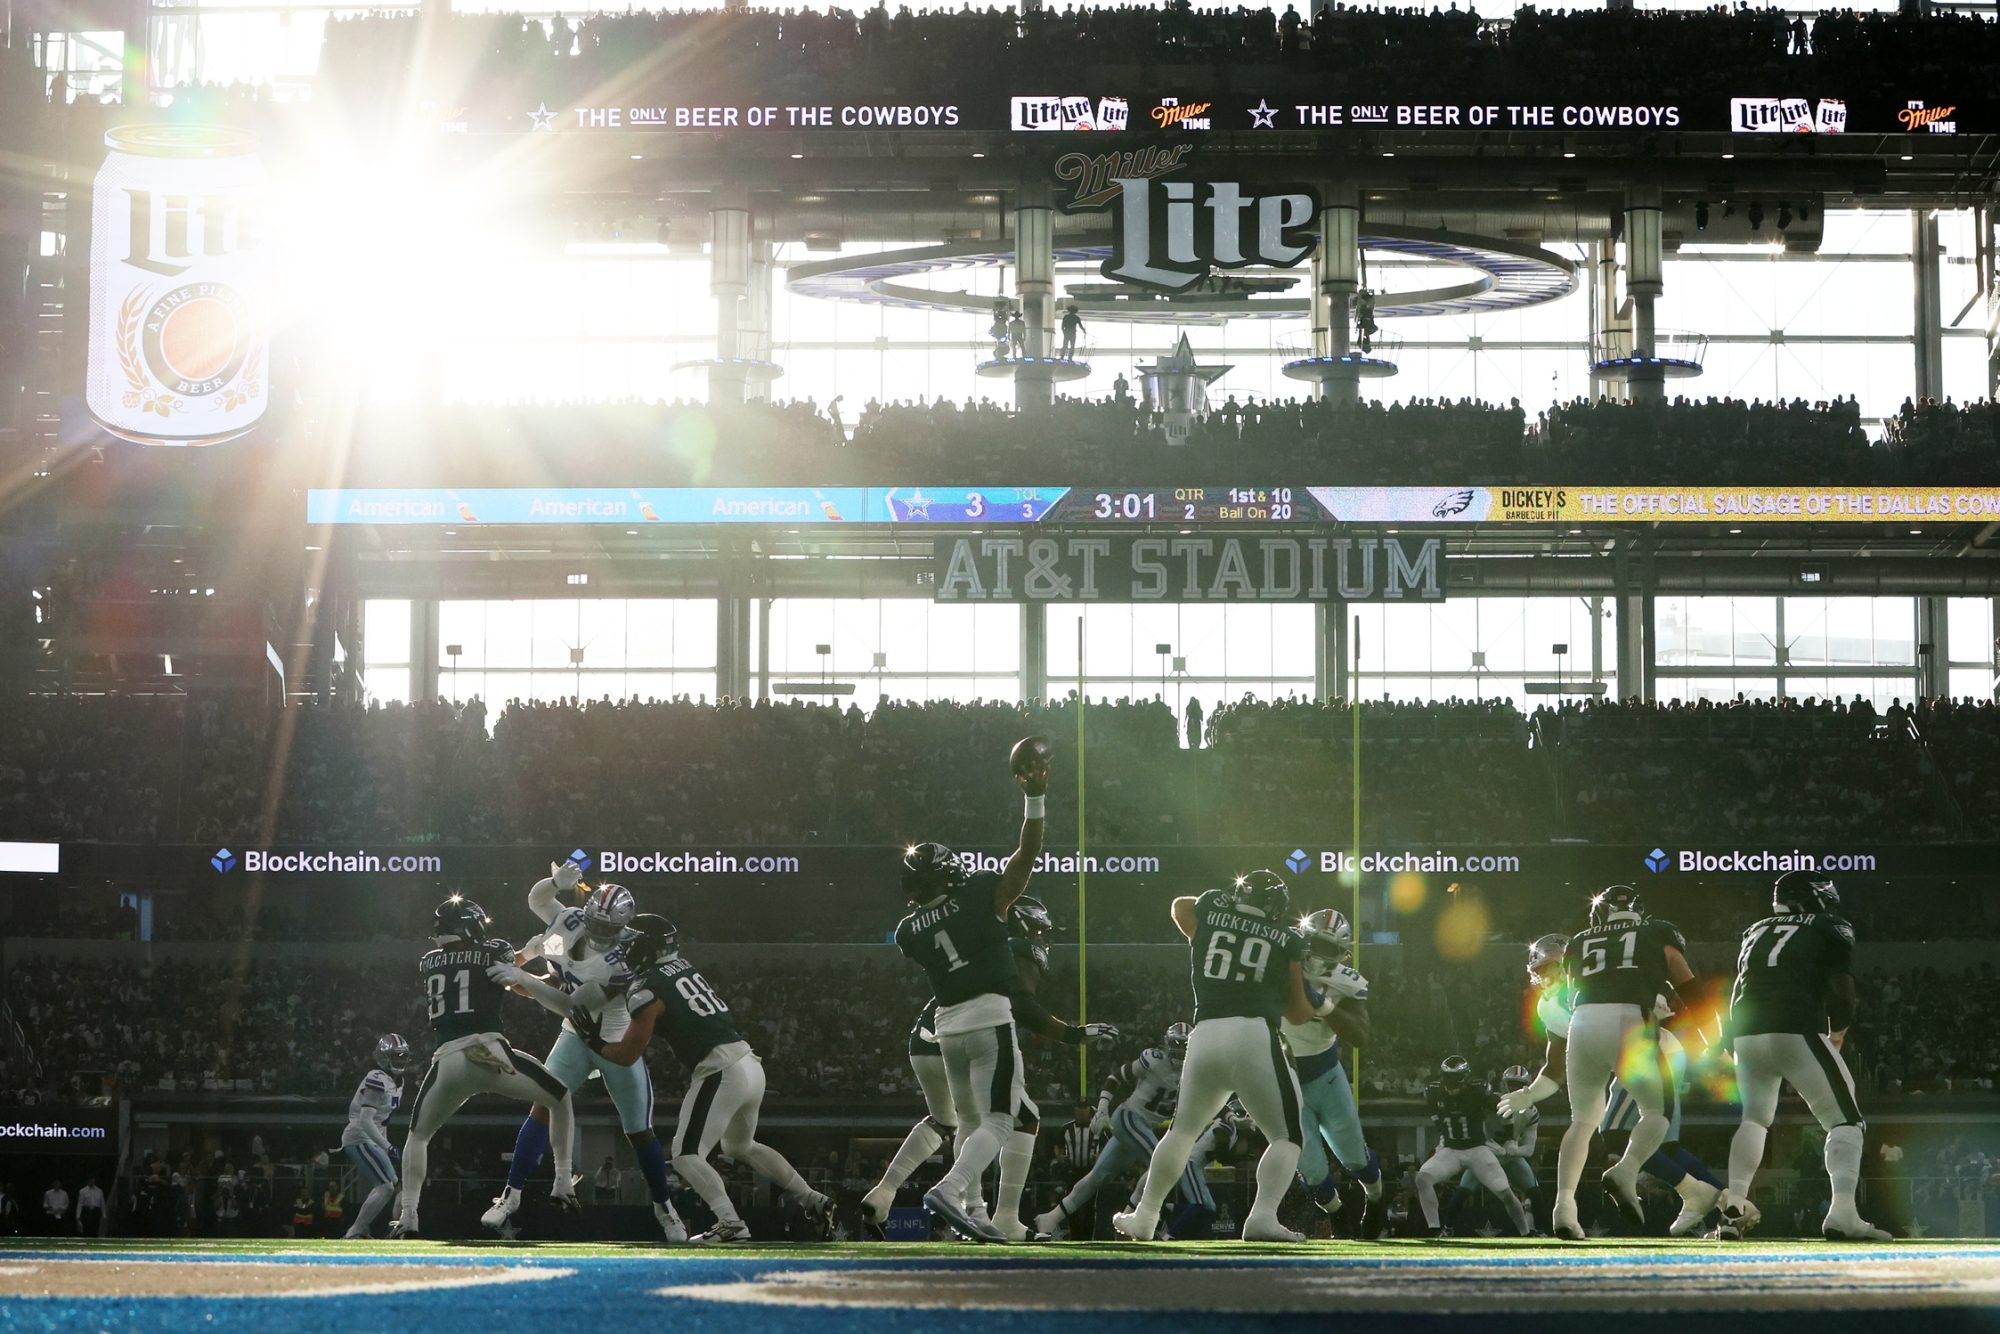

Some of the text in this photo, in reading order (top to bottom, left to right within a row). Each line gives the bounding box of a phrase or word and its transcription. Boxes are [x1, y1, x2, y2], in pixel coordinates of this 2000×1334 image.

[575, 106, 960, 127] THE ONLY BEER OF THE COWBOYS
[1020, 102, 1060, 129] Lite
[1062, 99, 1089, 124] Lite
[1103, 106, 1128, 123] Lite
[1152, 102, 1211, 128] Miller
[1296, 105, 1680, 126] THE ONLY BEER OF THE COWBOYS
[1740, 103, 1779, 130] Lite
[1781, 101, 1808, 125] Lite
[1822, 108, 1845, 125] Lite
[1898, 106, 1956, 131] Miller
[1182, 118, 1210, 130] TIME
[1928, 121, 1956, 133] TIME
[1055, 144, 1193, 208] Miller
[1110, 178, 1314, 287] Lite
[156, 288, 193, 319] FINE
[176, 377, 226, 394] BEER
[965, 492, 984, 518] 3
[1175, 488, 1204, 501] QTR
[1229, 488, 1256, 503] 1st
[1271, 488, 1292, 503] 10
[1502, 491, 1566, 508] DICKEYS
[1580, 495, 1618, 515] THE
[1623, 495, 1710, 515] OFFICIAL
[1714, 495, 1801, 515] SAUSAGE
[1806, 495, 1832, 515] OF
[1835, 495, 1873, 515] THE
[1878, 495, 1950, 515] DALLAS
[348, 498, 446, 516] American
[529, 497, 627, 517] American
[712, 496, 810, 516] American
[1022, 503, 1033, 518] 3
[1094, 494, 1155, 519] 3:01
[1184, 506, 1195, 519] 2
[1219, 504, 1292, 519] Ball On 20
[1505, 511, 1545, 520] BARBECUE
[938, 539, 1440, 599] AT&T STADIUM
[244, 850, 441, 872] Blockchain.com
[600, 851, 799, 873] Blockchain.com
[960, 851, 1160, 873] Blocchain.com
[1679, 849, 1876, 872] Blockchain.com
[1207, 910, 1291, 948] DICKERSON
[934, 929, 969, 972] 1
[1204, 930, 1272, 983] 69
[1582, 931, 1639, 976] 51
[427, 969, 475, 1020] 81
[675, 972, 729, 1017] 88
[1443, 1116, 1469, 1140] 11
